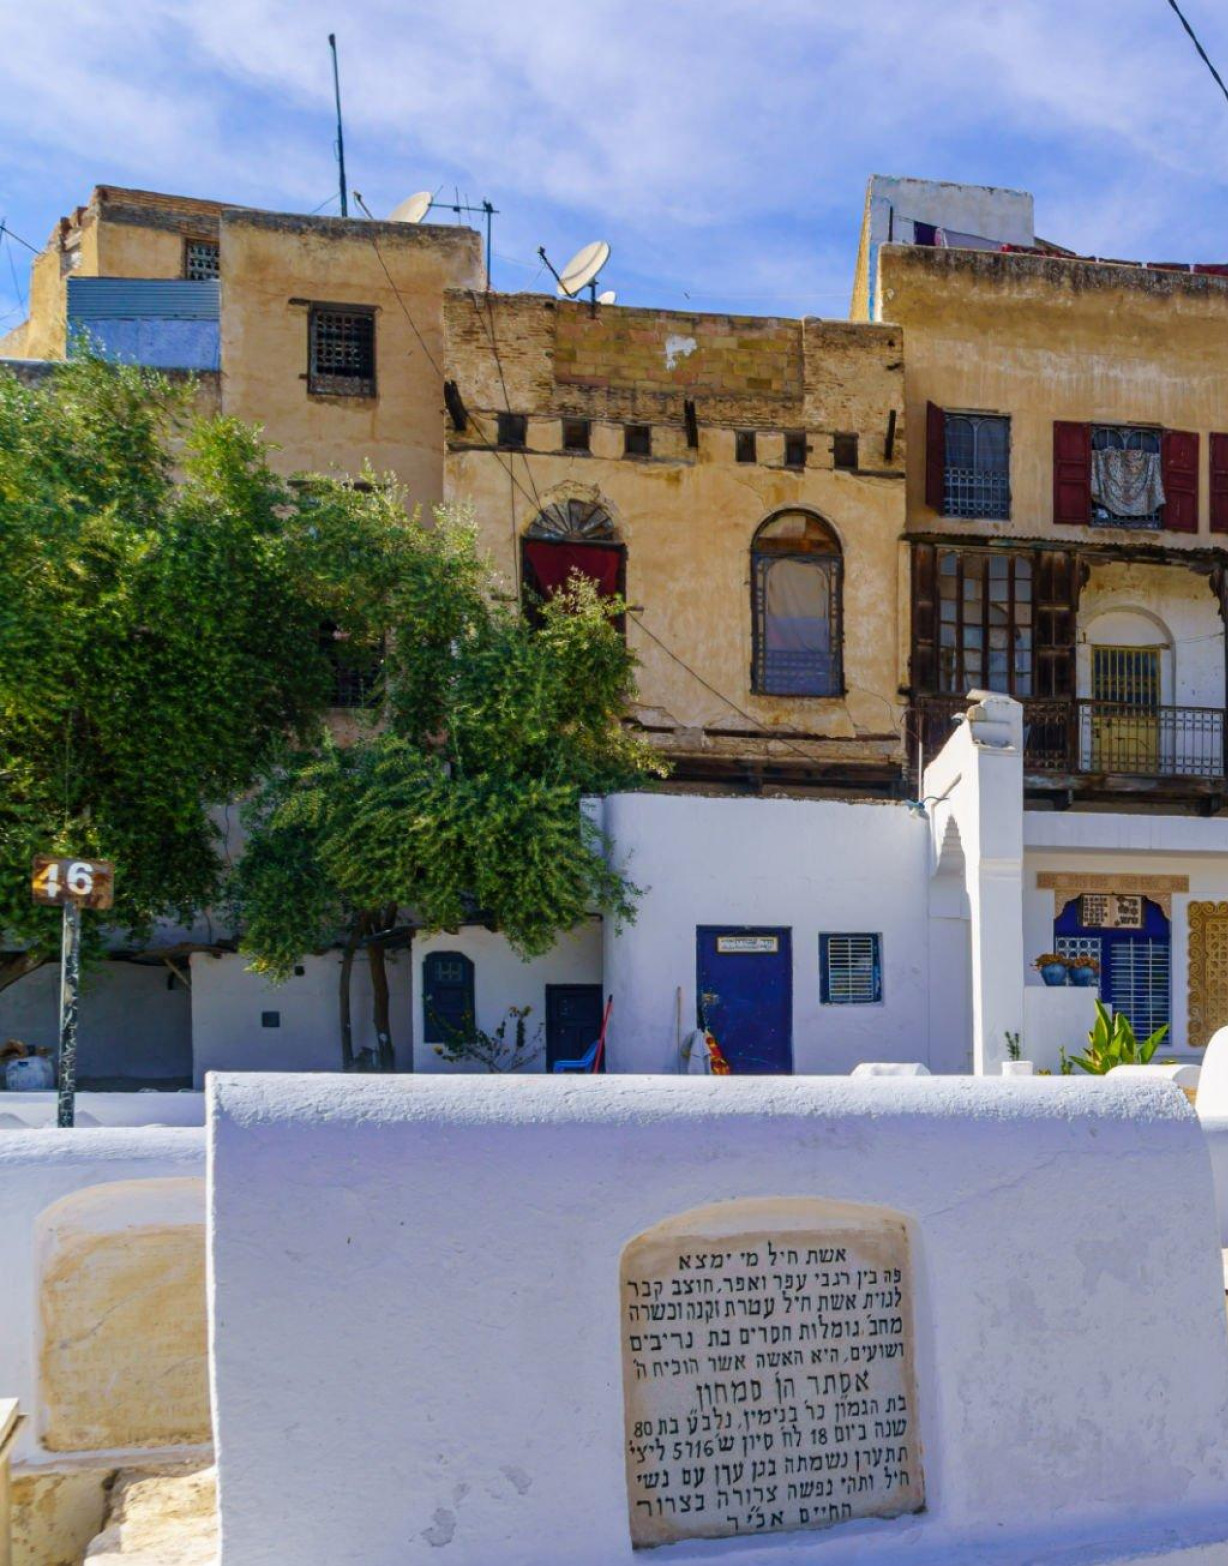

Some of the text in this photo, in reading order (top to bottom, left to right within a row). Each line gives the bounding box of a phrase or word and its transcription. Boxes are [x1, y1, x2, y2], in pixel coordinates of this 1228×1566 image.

[32, 861, 94, 898] 46
[679, 1240, 846, 1270] אשת חיל מי ימצא
[773, 1274, 806, 1292] עפר
[858, 1270, 877, 1290] בין
[884, 1268, 900, 1283] פה
[628, 1281, 662, 1300] קבר
[724, 1297, 774, 1319] עטרת
[782, 1290, 811, 1313] חיל
[817, 1294, 856, 1312] אשת
[708, 1330, 730, 1347] בת
[708, 1354, 746, 1372] אשר
[756, 1350, 804, 1368] האשה
[811, 1348, 838, 1364] היא
[653, 1358, 698, 1377] הוכיח
[807, 1370, 870, 1396] אסתר
[885, 1395, 906, 1412] בת
[634, 1422, 653, 1438] 80
[658, 1418, 678, 1436] בת
[811, 1428, 828, 1445] 18
[835, 1424, 866, 1442] ביום
[874, 1418, 906, 1438] שנה
[742, 1432, 773, 1456] סיון
[752, 1459, 776, 1482] בגן
[784, 1451, 848, 1474] נשמתה
[636, 1470, 669, 1488] נשי
[682, 1467, 705, 1488] עם
[636, 1466, 910, 1516] חיל ותהי נפשה צרורה בצרור
[800, 1502, 852, 1524] החיים
